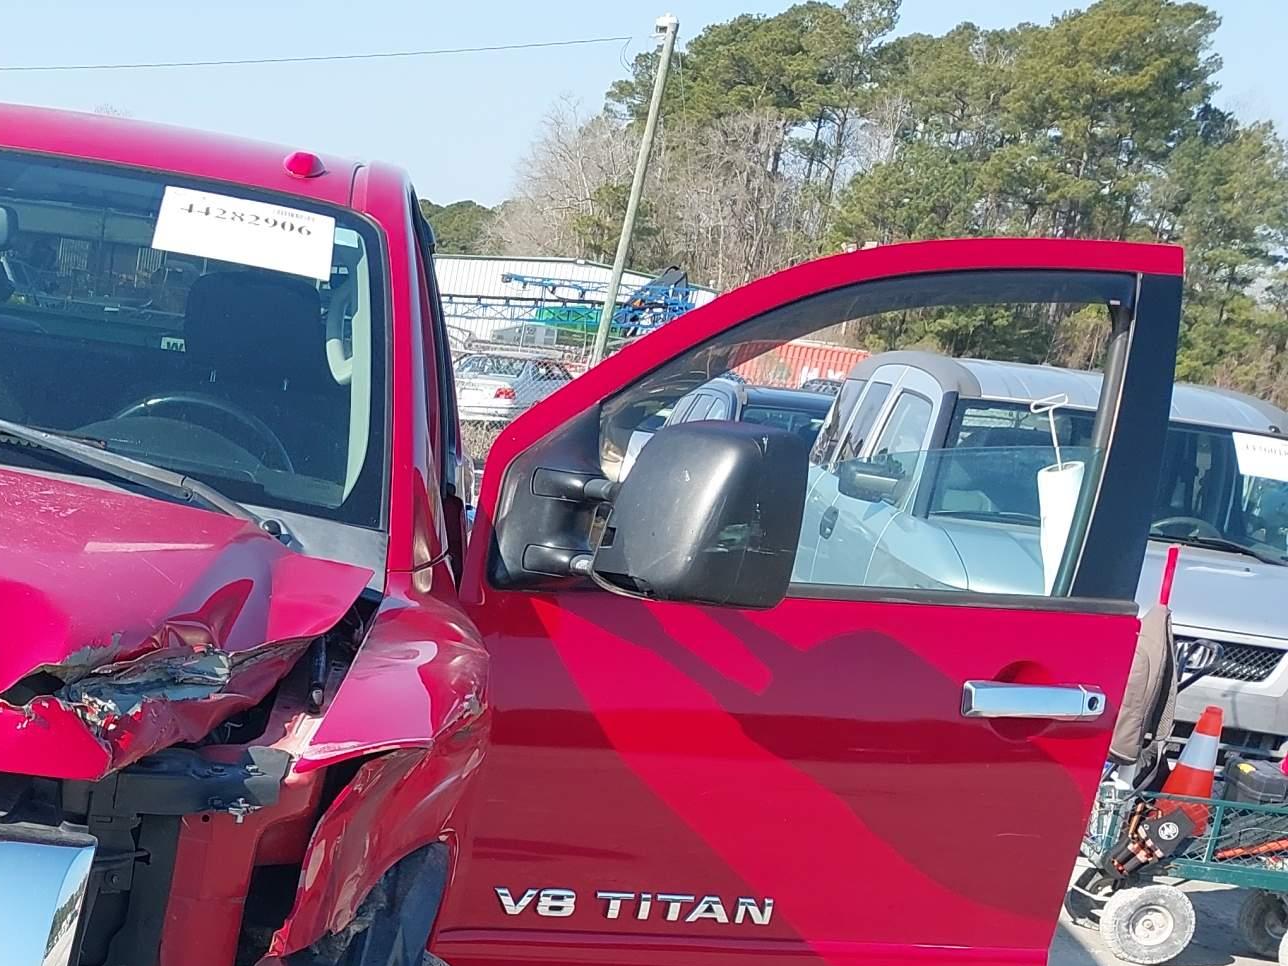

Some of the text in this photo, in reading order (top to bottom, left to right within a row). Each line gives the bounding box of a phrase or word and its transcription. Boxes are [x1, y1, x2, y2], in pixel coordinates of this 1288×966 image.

[180, 203, 312, 236] 44282906
[495, 887, 774, 925] V8 TITAN
